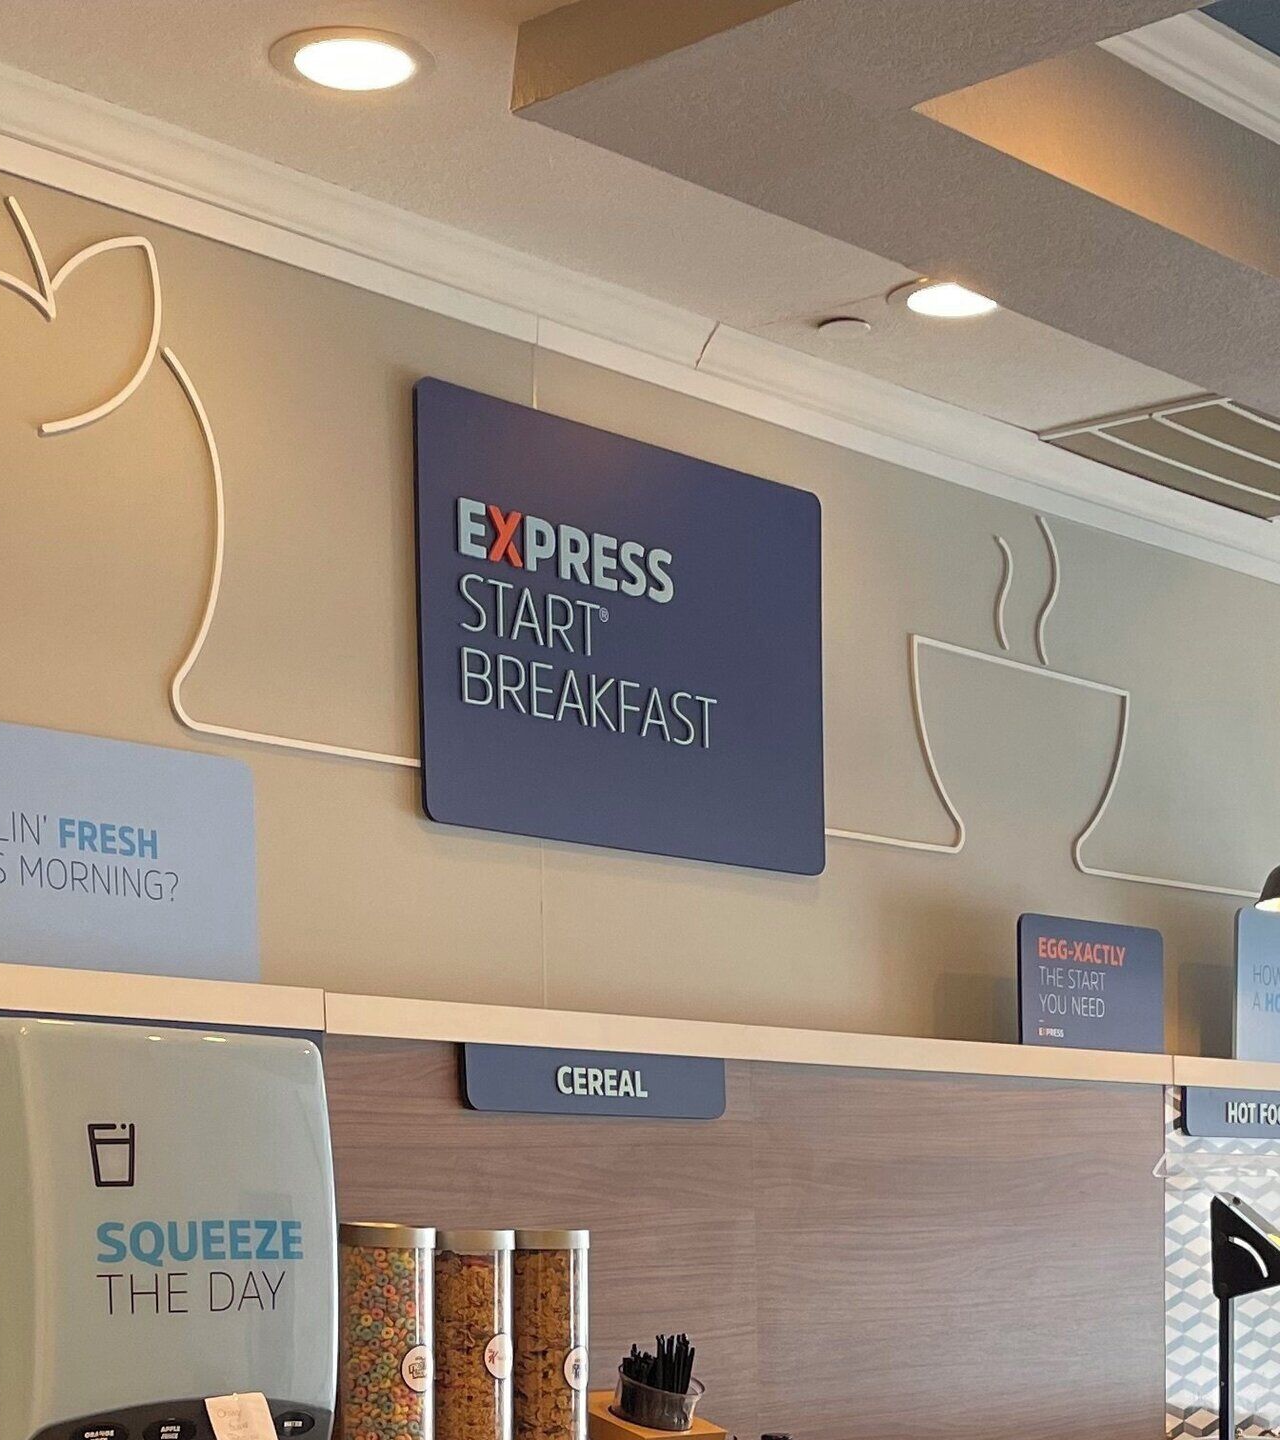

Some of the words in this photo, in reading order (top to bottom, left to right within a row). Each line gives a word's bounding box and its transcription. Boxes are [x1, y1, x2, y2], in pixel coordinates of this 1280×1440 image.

[457, 497, 674, 604] EXPRESS
[461, 646, 717, 749] BREAKFAST
[58, 817, 158, 860] FRESH
[19, 854, 179, 902] MORNING?
[1038, 936, 1126, 967] EGG-XACTLY
[1038, 965, 1064, 988] THE
[1068, 968, 1106, 991] START
[1038, 993, 1067, 1015] YOU
[1071, 995, 1105, 1018] NEED
[1252, 991, 1261, 1011] A
[556, 1065, 648, 1098] CEREAL
[1226, 1101, 1256, 1125] HOT
[96, 1219, 303, 1267] SQUEEZE
[96, 1272, 188, 1316] THE
[208, 1270, 286, 1312] DAY
